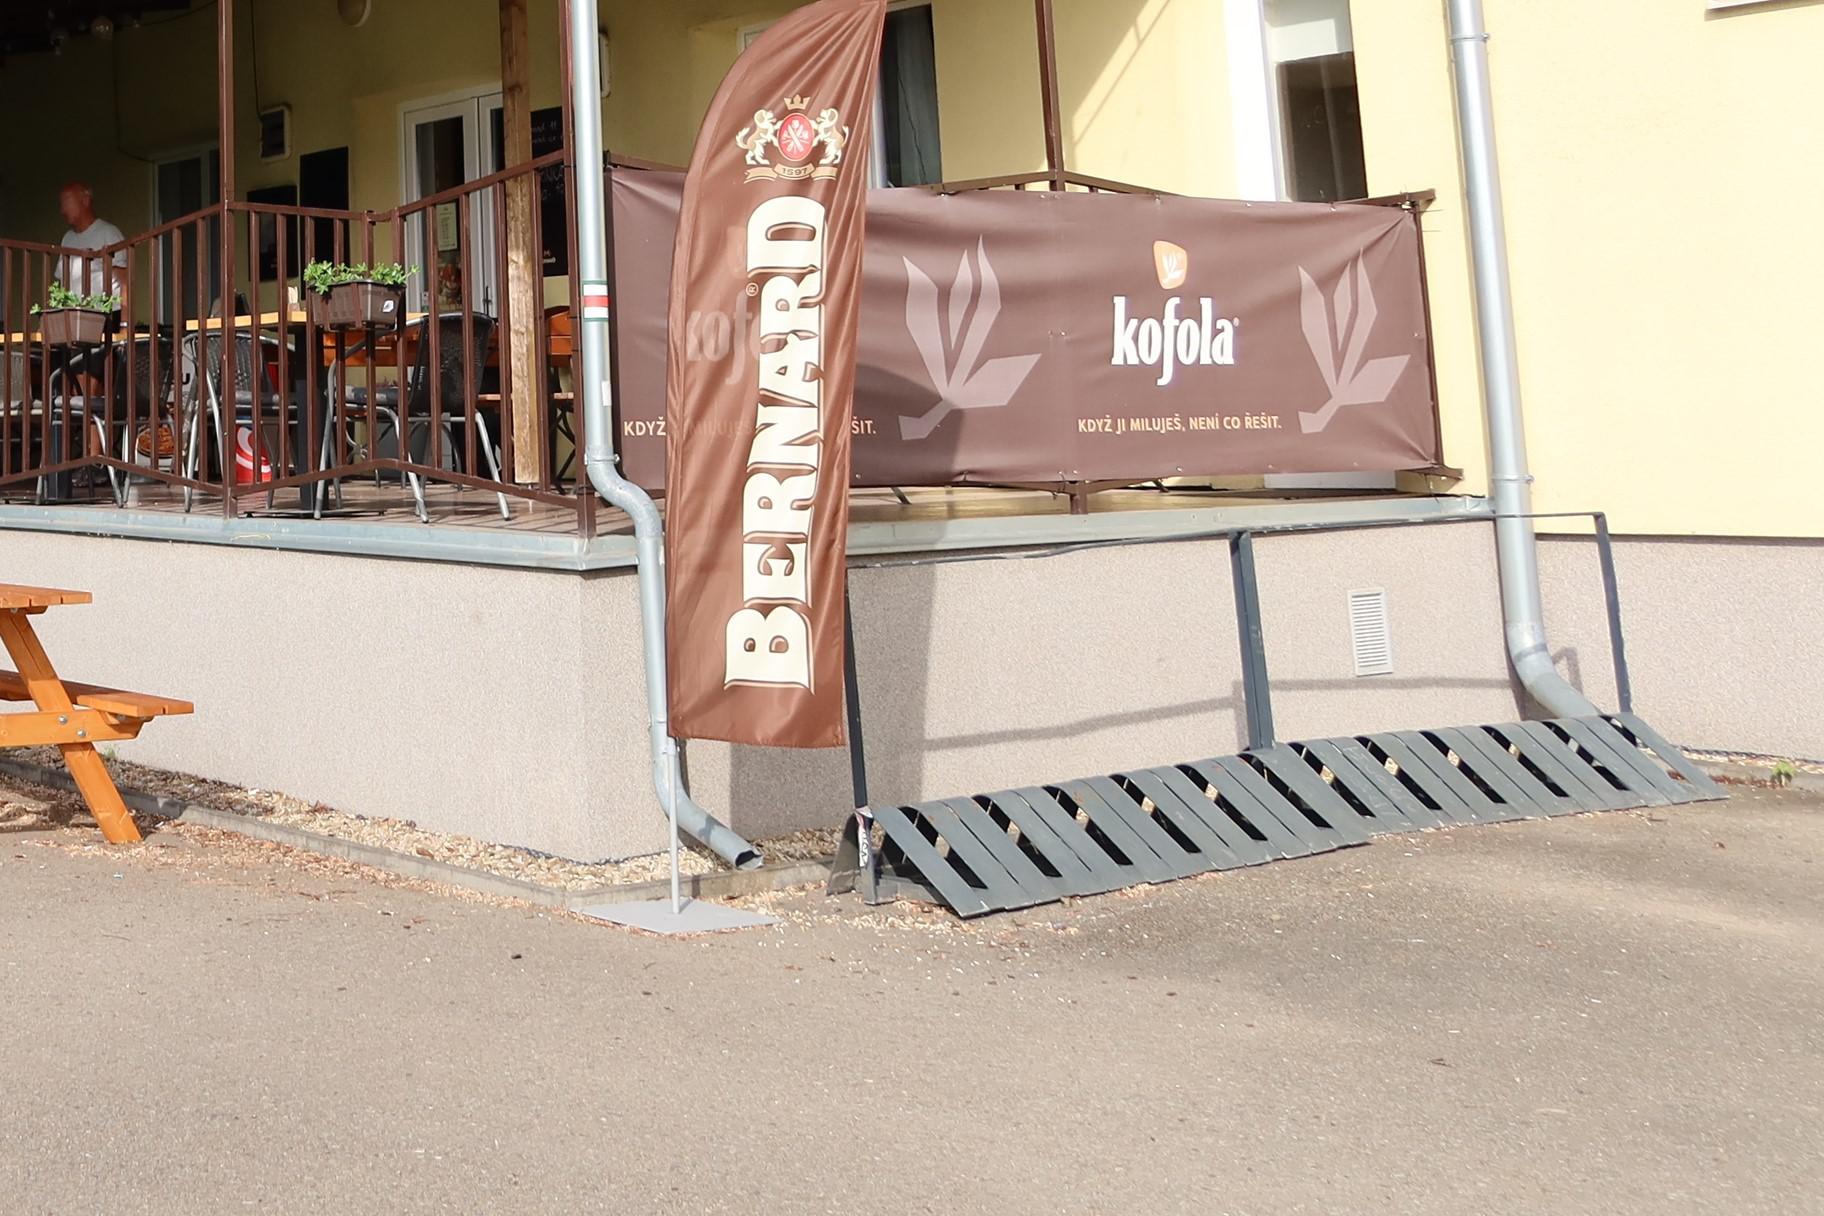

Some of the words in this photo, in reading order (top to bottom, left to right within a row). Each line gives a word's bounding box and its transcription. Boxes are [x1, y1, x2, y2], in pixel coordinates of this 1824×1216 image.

[782, 167, 808, 176] 1597
[1111, 295, 1235, 386] kofola
[623, 416, 666, 436] KDYŽ
[851, 418, 877, 434] ŠIT.
[1078, 415, 1113, 432] KDYŽ
[1115, 419, 1126, 434] JI
[1130, 413, 1186, 433] MILUJEŠ,
[1188, 413, 1219, 430] NENÍ
[1223, 416, 1241, 429] CO
[1244, 412, 1282, 430] ŘEŠIT.
[723, 195, 828, 695] BERNARD
